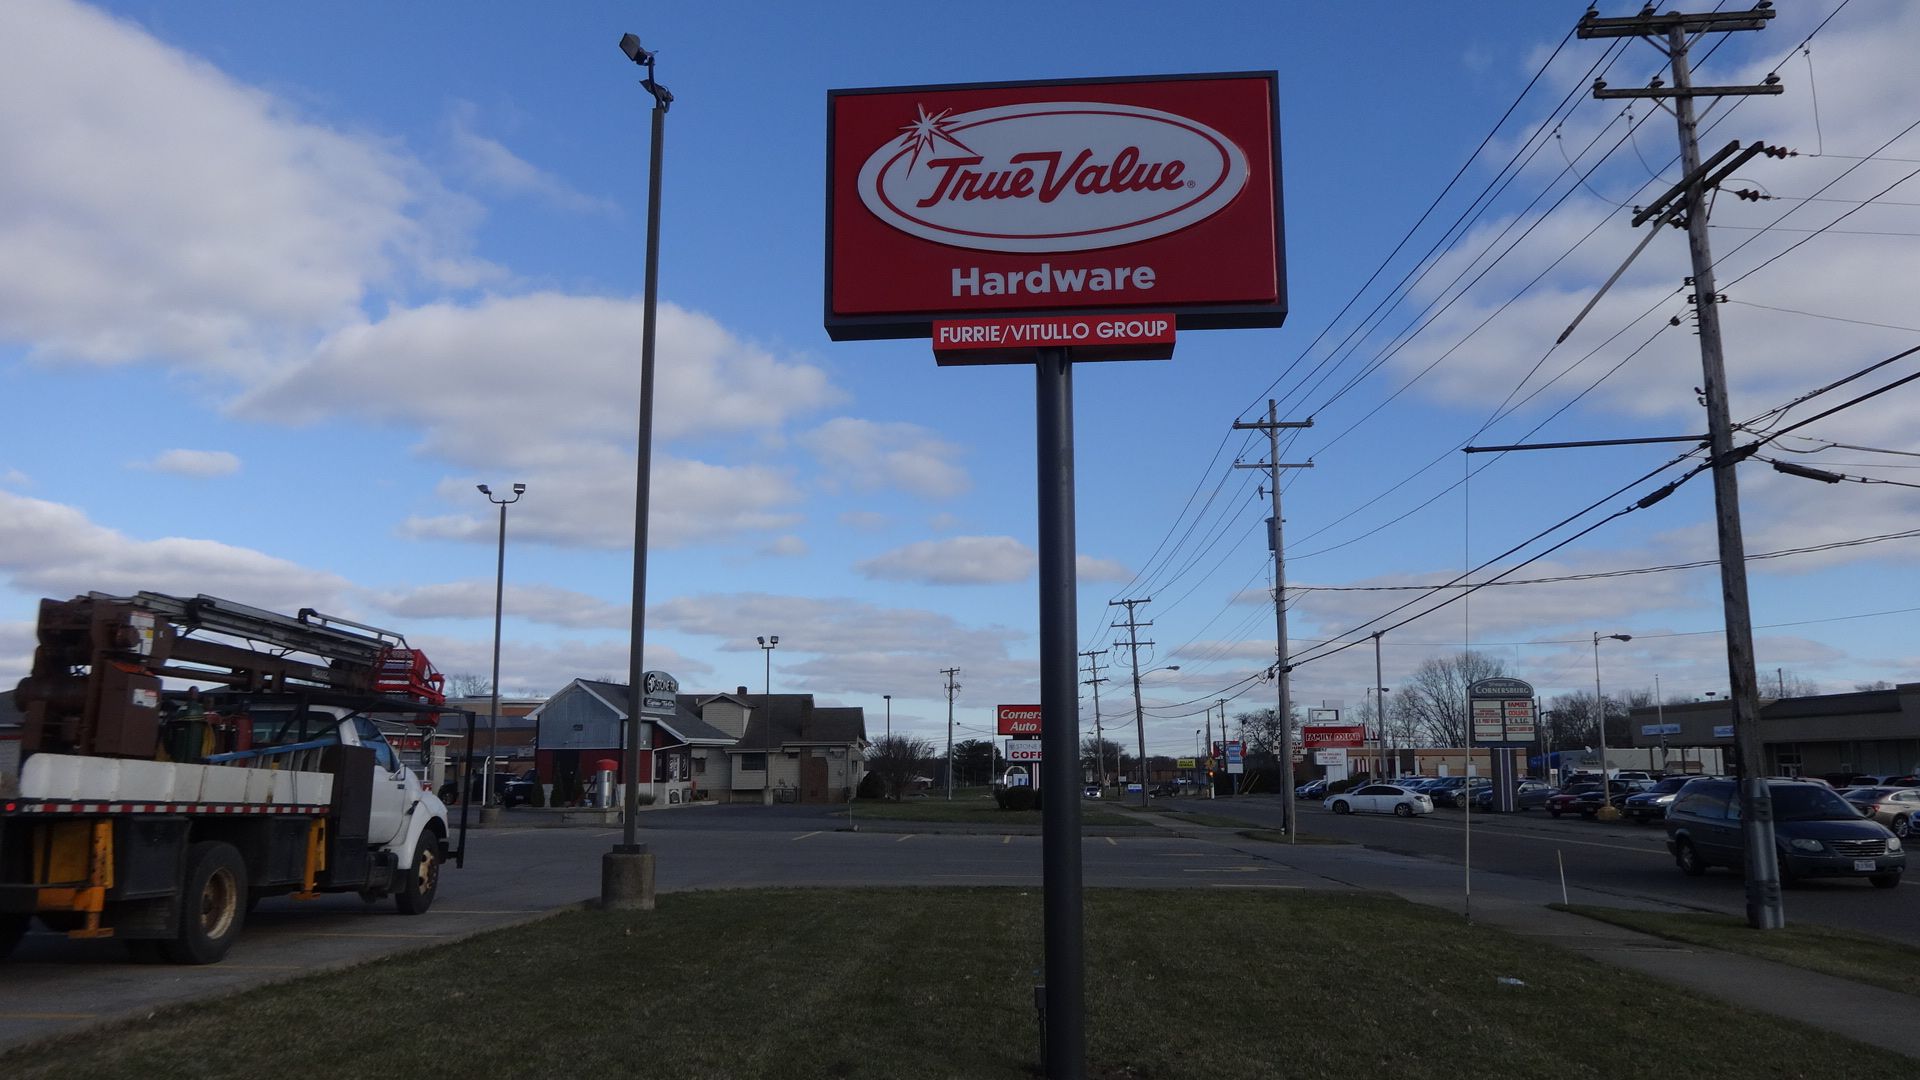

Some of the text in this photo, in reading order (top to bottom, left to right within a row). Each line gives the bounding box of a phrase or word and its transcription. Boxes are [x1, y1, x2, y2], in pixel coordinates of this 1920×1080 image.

[951, 263, 1156, 297] Hardware
[939, 320, 1169, 344] FURRIE/VITULLO GROUP
[1010, 721, 1037, 731] Auto
[1306, 732, 1360, 742] FAMILY DOLLAR
